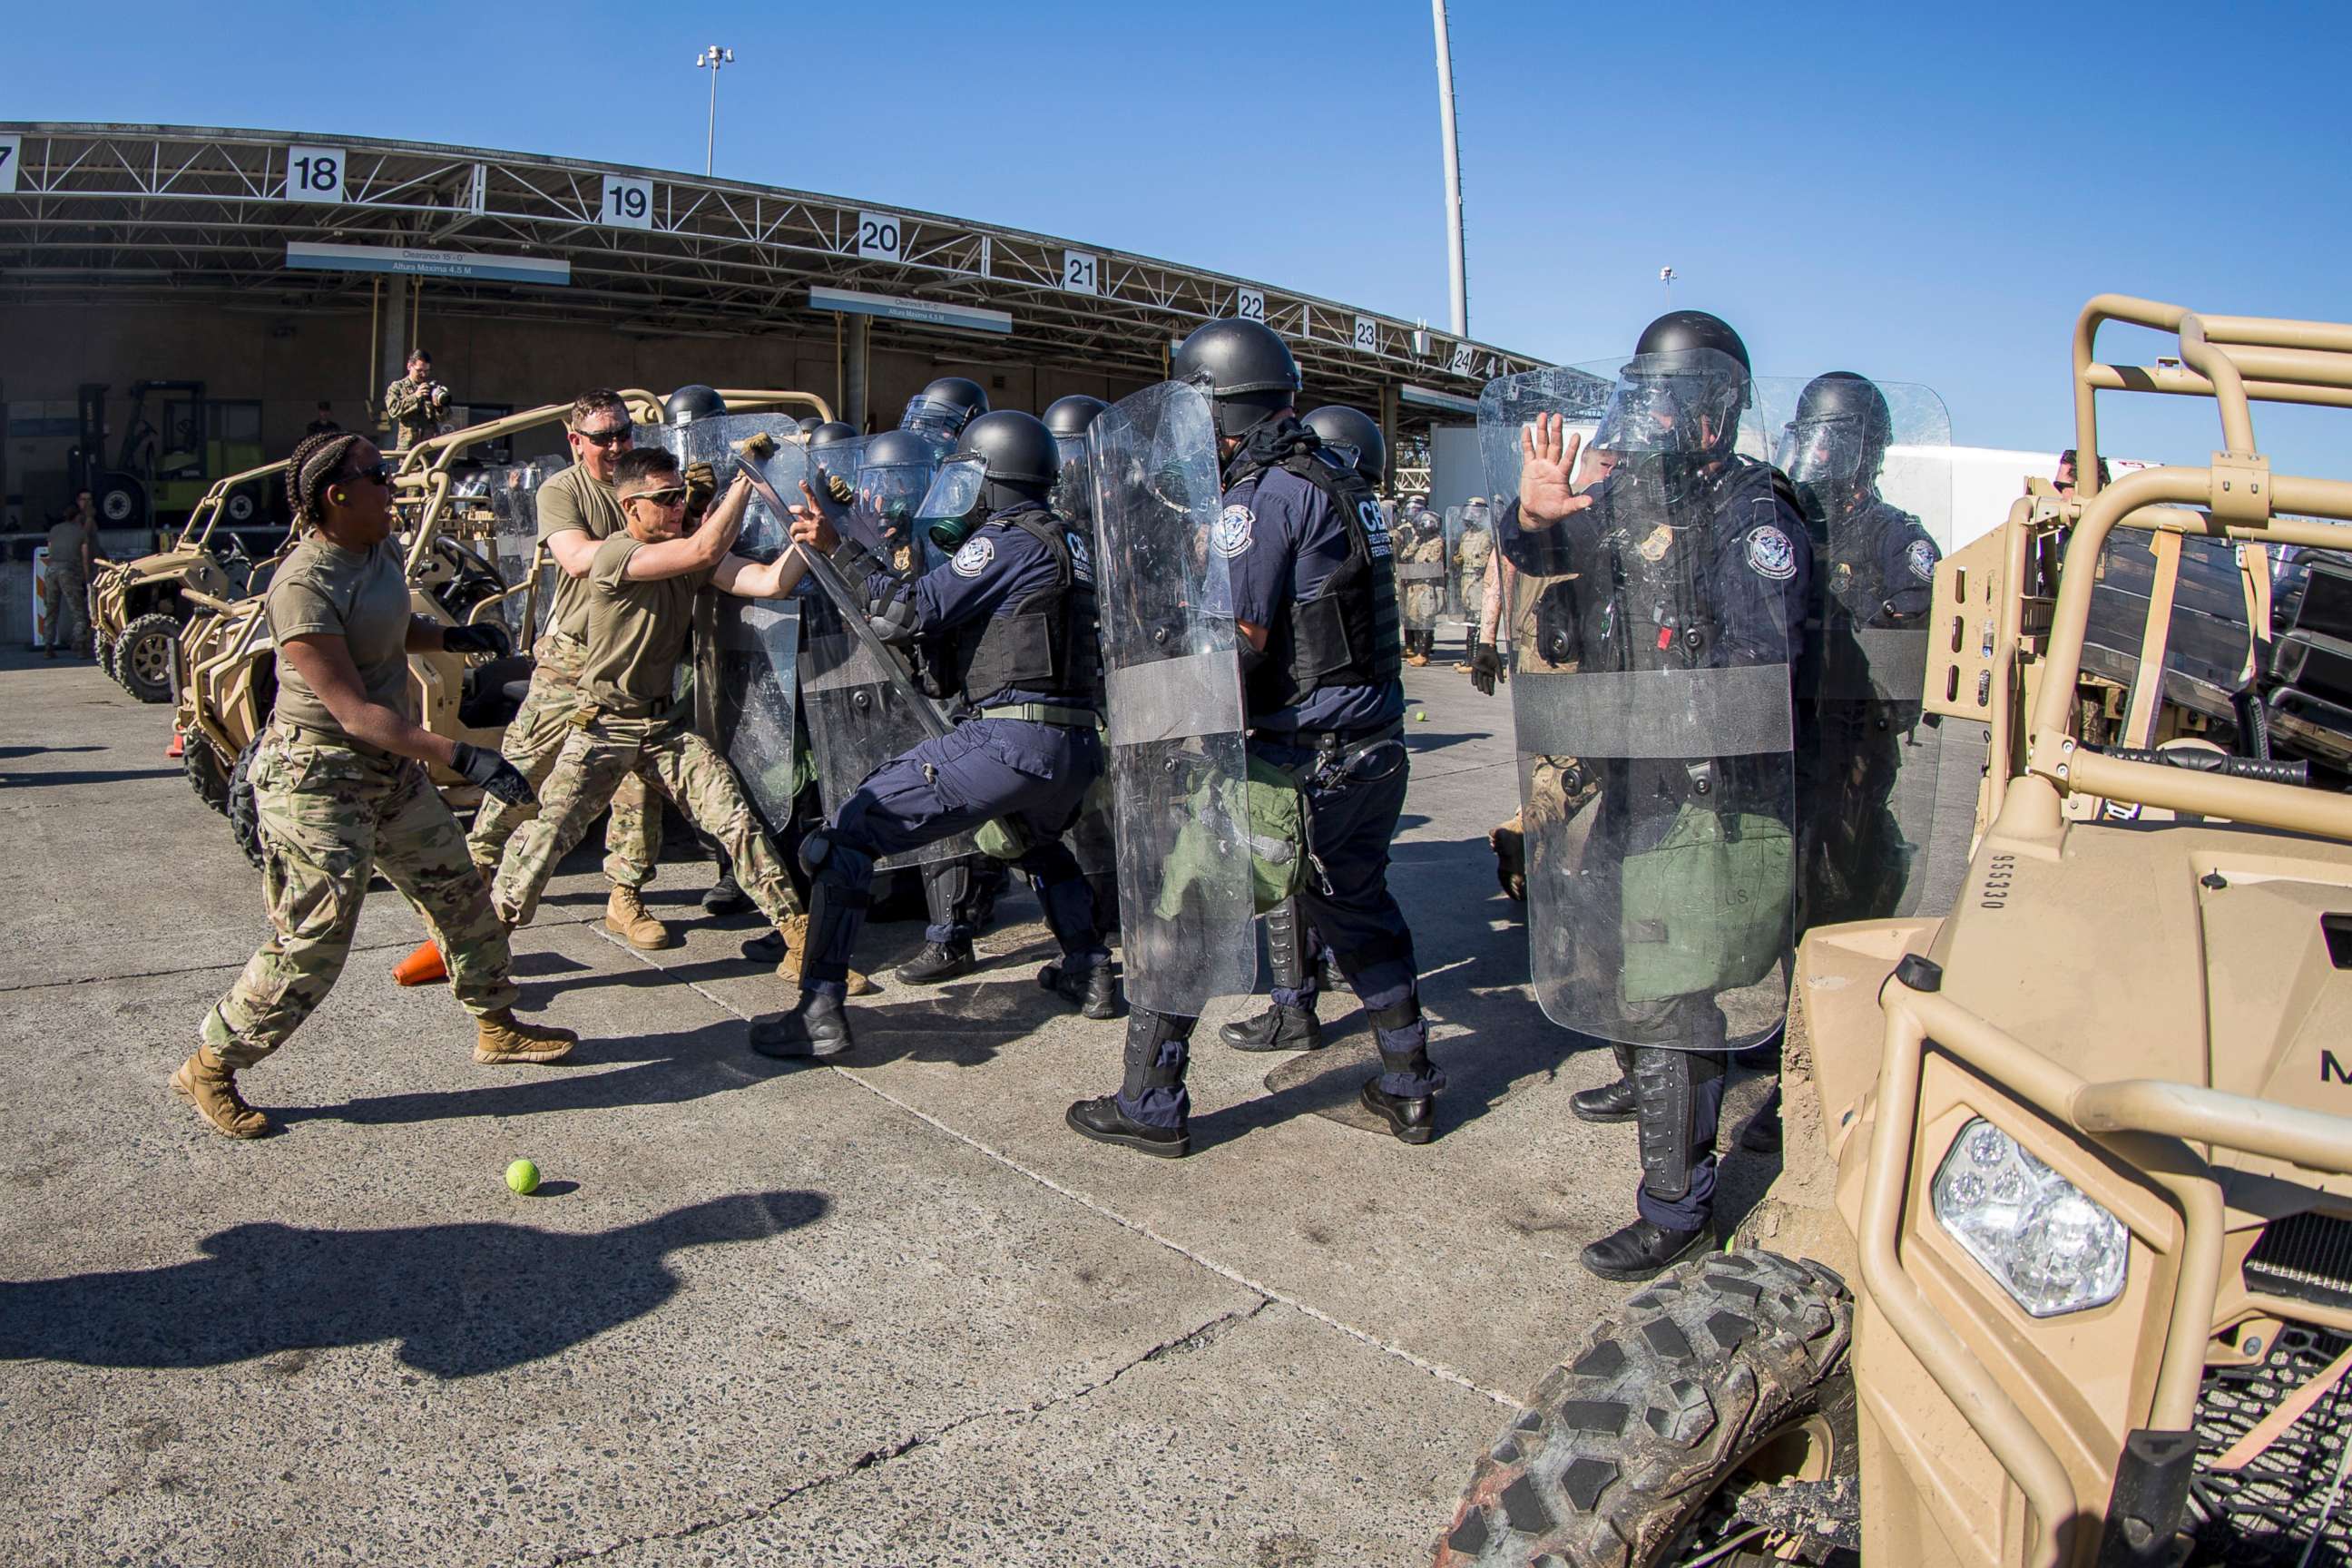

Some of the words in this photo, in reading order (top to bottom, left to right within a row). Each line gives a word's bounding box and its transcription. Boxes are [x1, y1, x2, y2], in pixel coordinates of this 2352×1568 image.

[294, 157, 338, 191] 18
[609, 185, 647, 219] 19
[862, 221, 897, 252] 20
[464, 266, 471, 274] M
[1069, 259, 1093, 287] 21
[1241, 295, 1262, 319] 22
[1357, 323, 1375, 345] 23
[1455, 350, 1471, 370] 24
[1981, 856, 2015, 908] 955330
